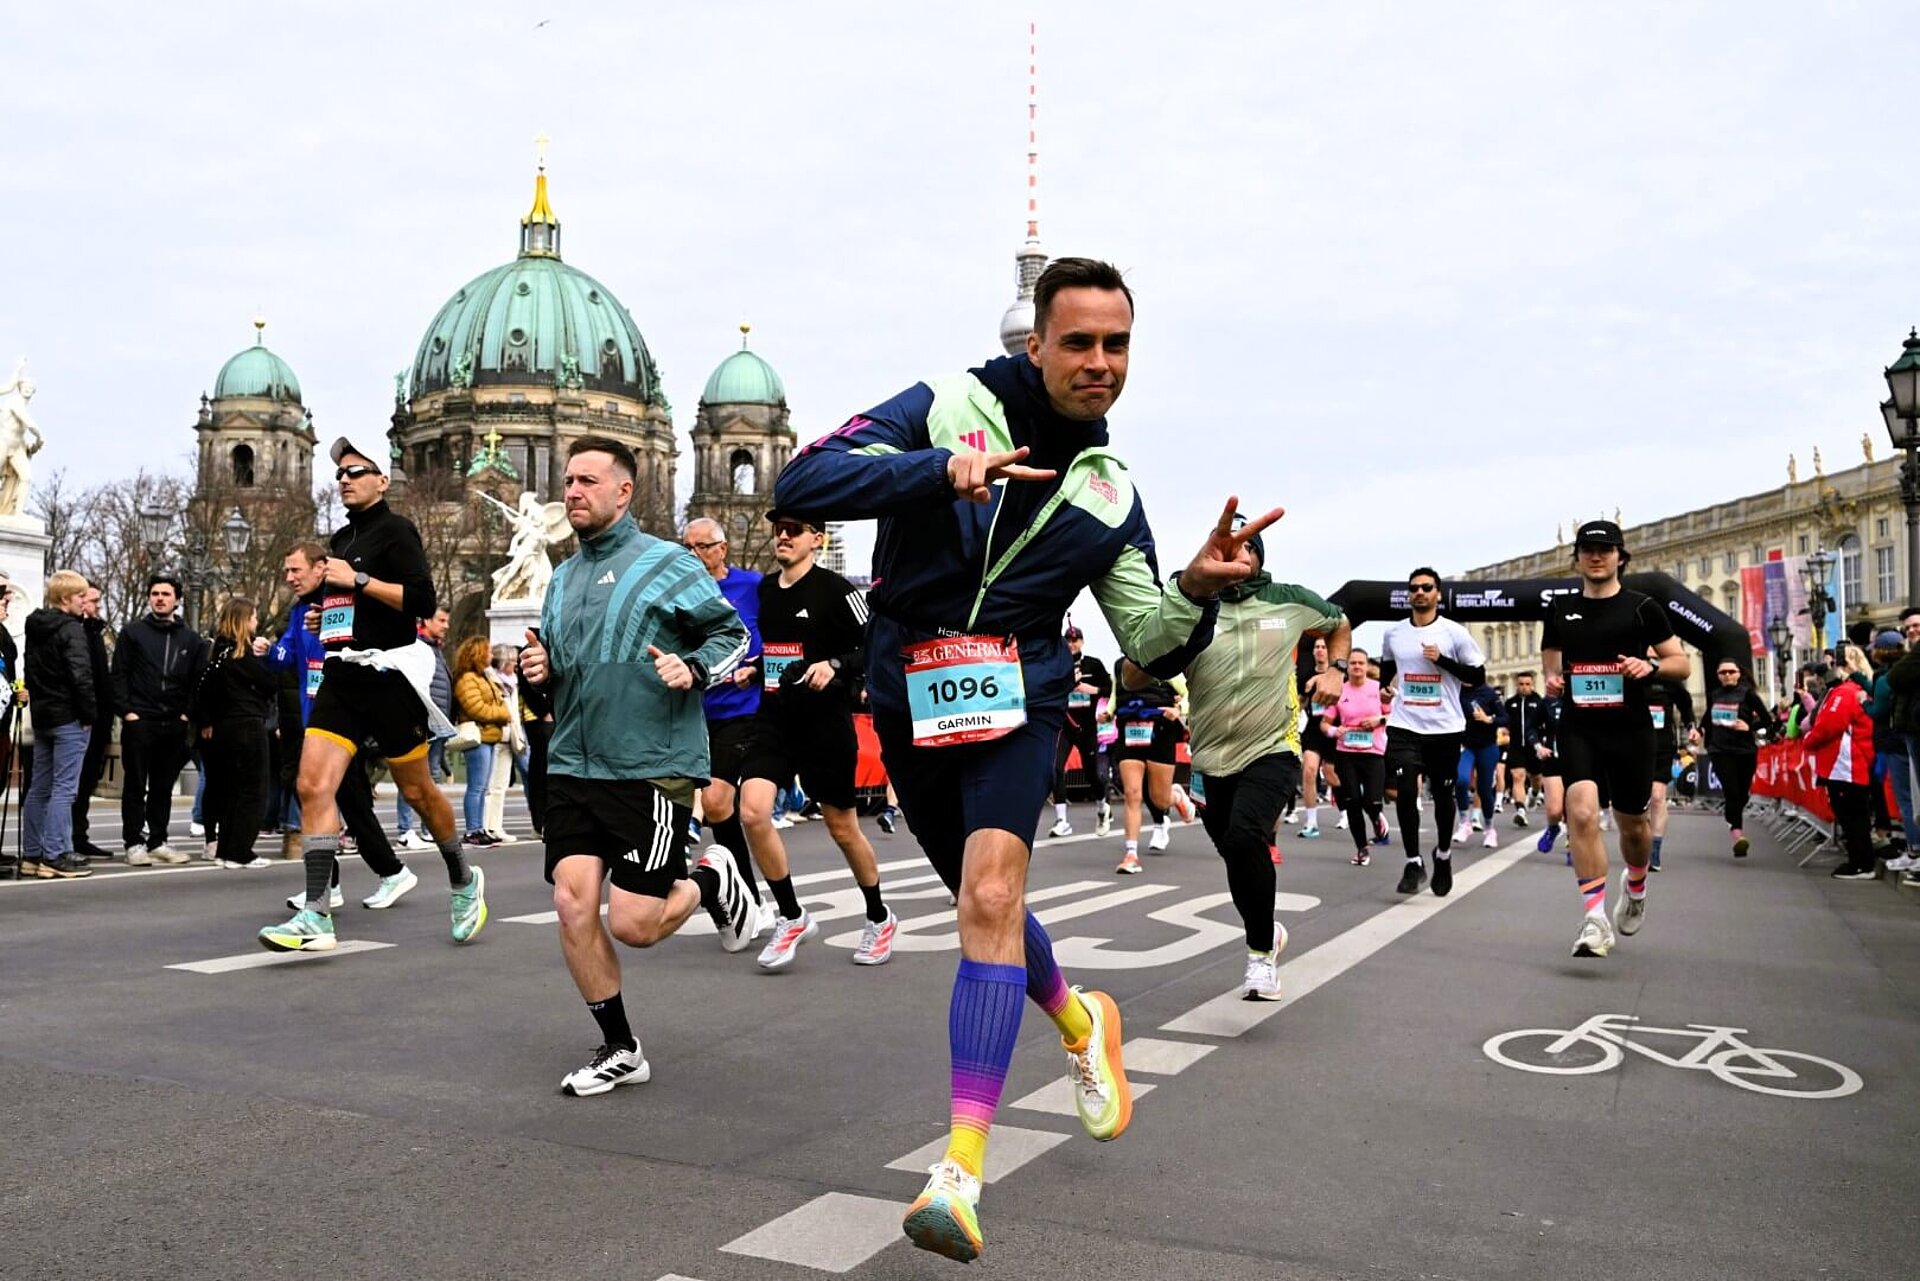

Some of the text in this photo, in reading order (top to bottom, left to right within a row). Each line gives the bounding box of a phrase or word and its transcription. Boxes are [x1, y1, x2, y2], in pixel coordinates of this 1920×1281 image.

[1456, 598, 1515, 607] BERLIN MILE
[1668, 601, 1713, 633] GARMIN
[766, 662, 784, 673] 276
[928, 675, 999, 705] 1096
[1584, 680, 1606, 691] 311
[937, 715, 992, 731] GARMIN
